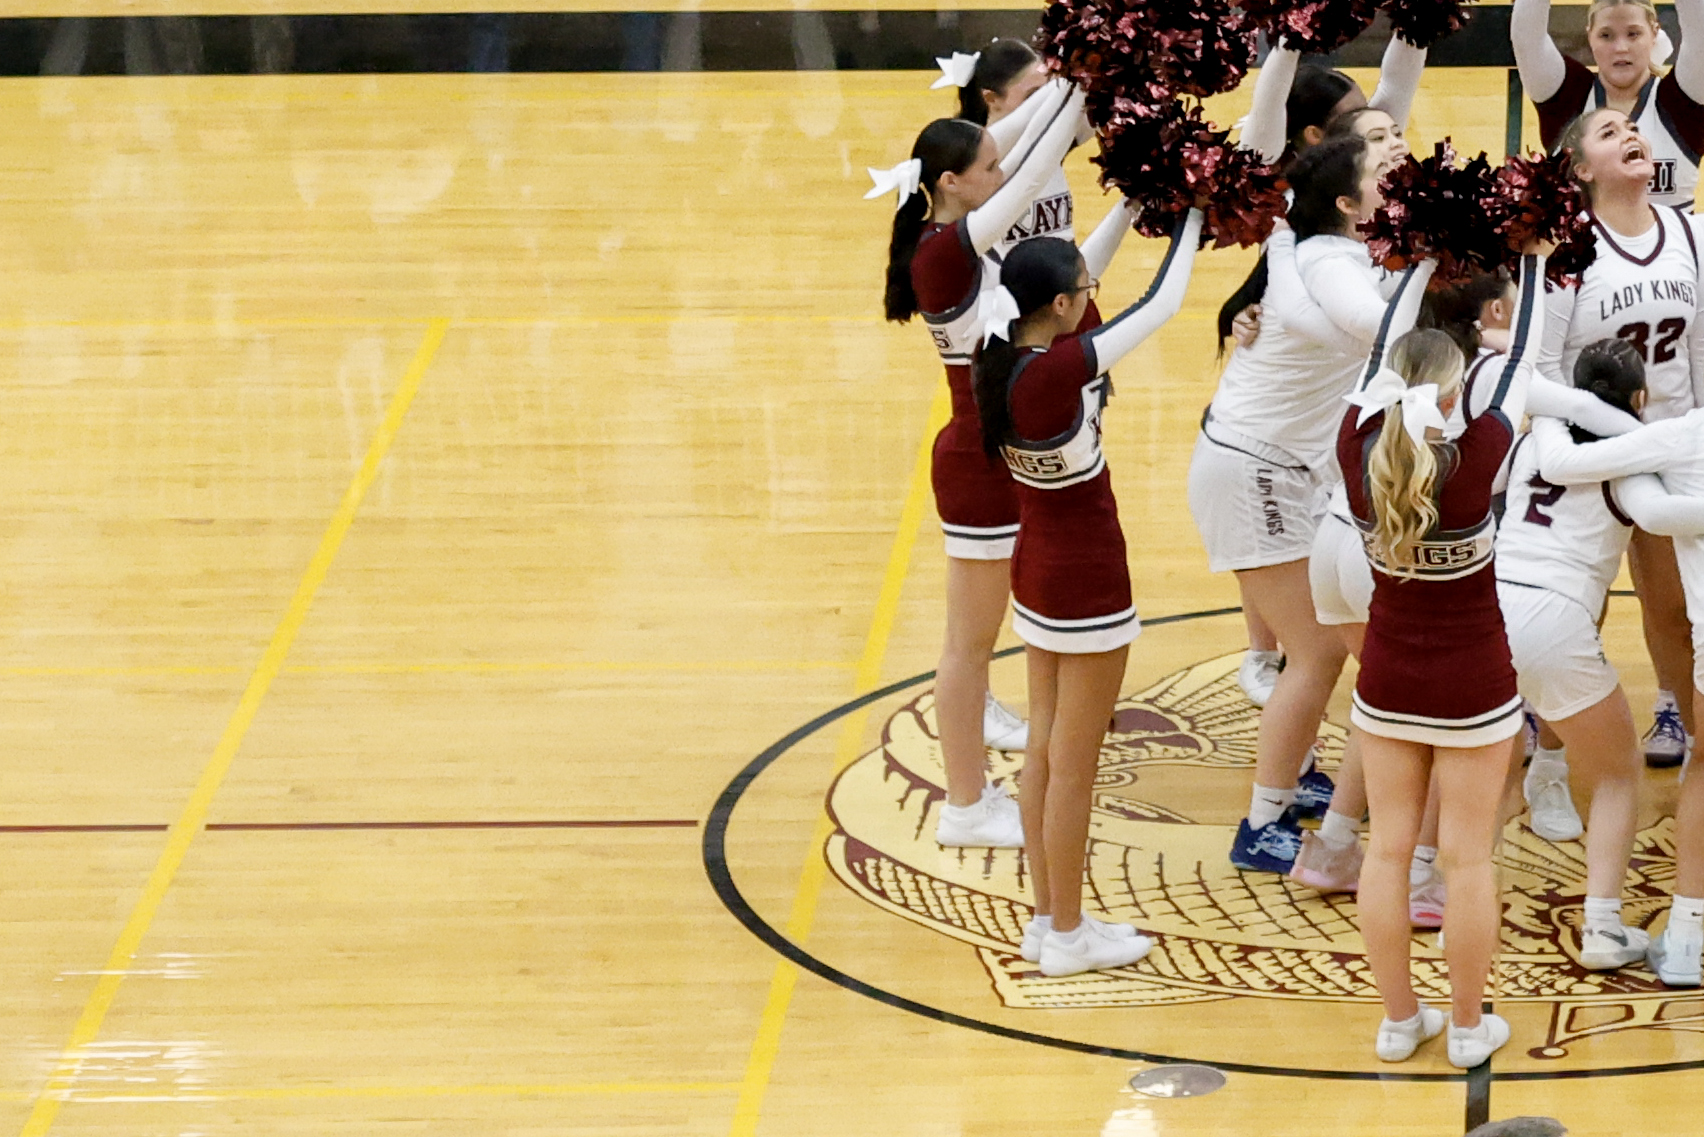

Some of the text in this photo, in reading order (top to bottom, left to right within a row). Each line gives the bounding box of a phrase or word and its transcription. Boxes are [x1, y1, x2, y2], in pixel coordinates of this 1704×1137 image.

[1003, 191, 1074, 244] KAY
[1600, 280, 1695, 322] LADY KINGS
[1262, 499, 1286, 536] KINGS
